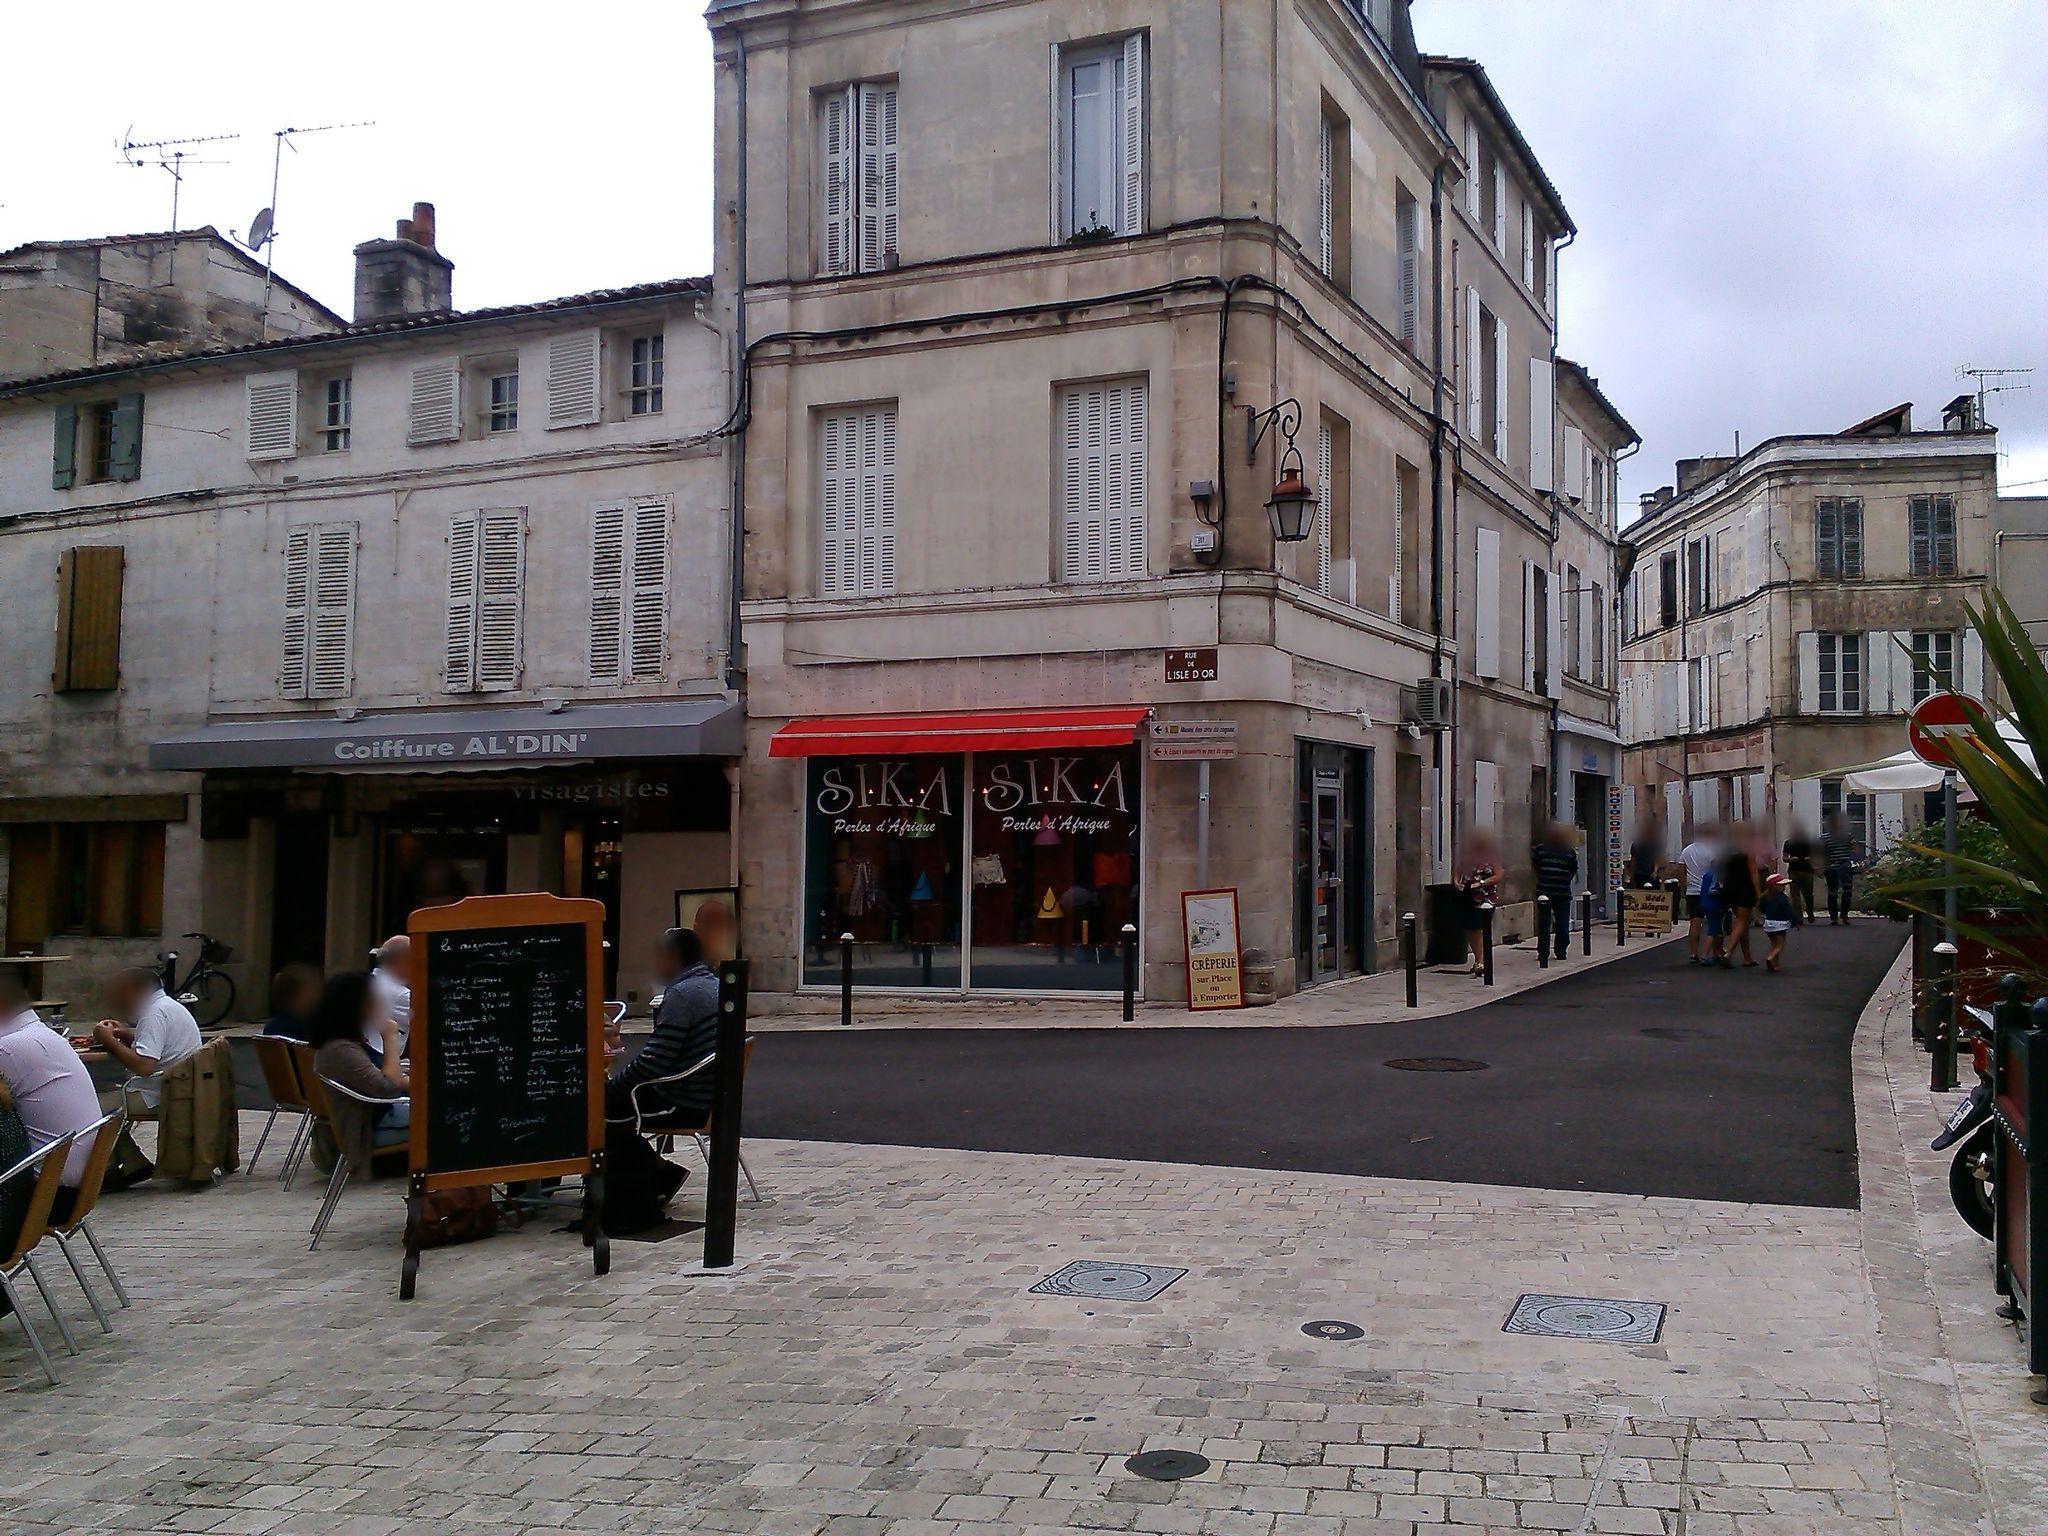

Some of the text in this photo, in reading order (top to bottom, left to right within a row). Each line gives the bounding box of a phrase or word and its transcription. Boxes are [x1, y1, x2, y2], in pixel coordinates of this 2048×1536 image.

[1184, 652, 1198, 660] RUE
[334, 733, 587, 760] Coiffure AL'DIN'
[511, 777, 670, 803] visagistes
[816, 761, 953, 816] SIKA
[983, 756, 1130, 813] SIKA
[833, 817, 936, 837] Perles d'Afrique
[1001, 815, 1111, 835] Perles d'Afrique
[1192, 957, 1237, 970] CRÊPERIE
[1196, 974, 1232, 984] sur Place
[1193, 993, 1238, 1002] à Emporter
